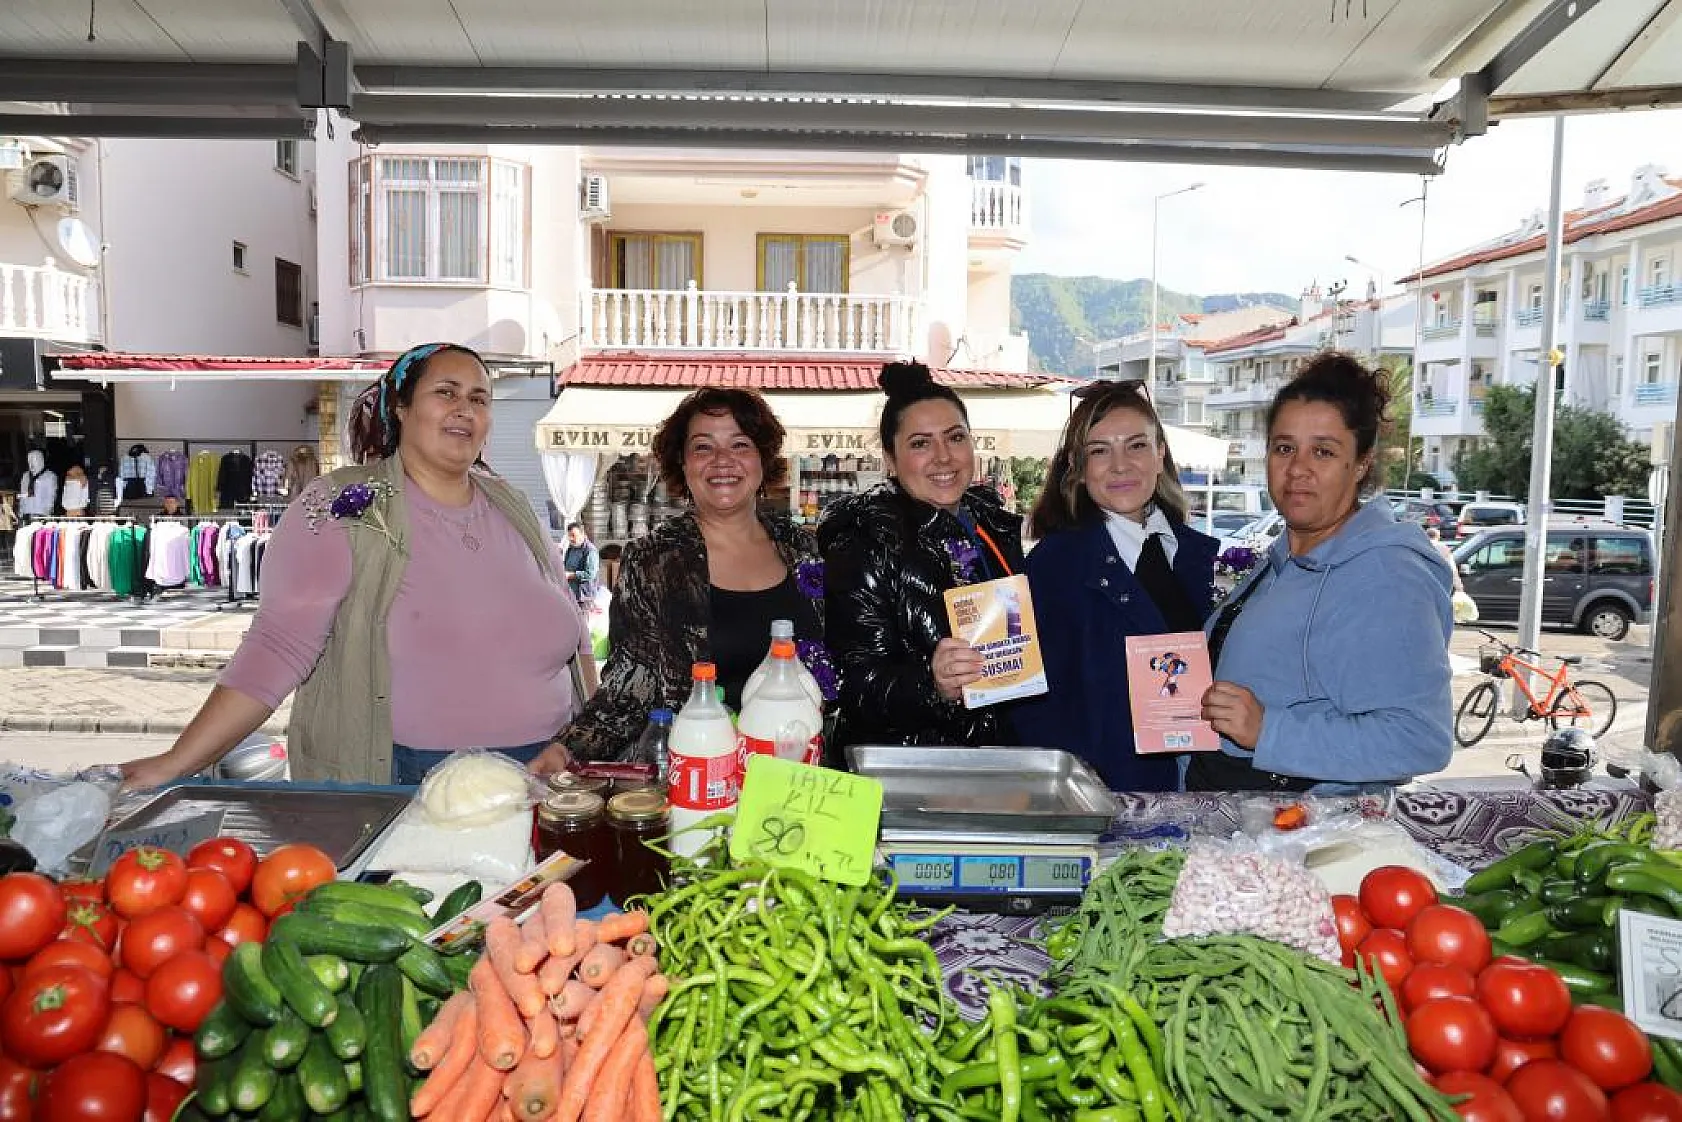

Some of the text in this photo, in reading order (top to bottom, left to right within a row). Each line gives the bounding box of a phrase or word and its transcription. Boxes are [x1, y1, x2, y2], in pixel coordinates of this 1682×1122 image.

[552, 427, 651, 446] EVİM ZÜ
[807, 431, 863, 449] EVİM
